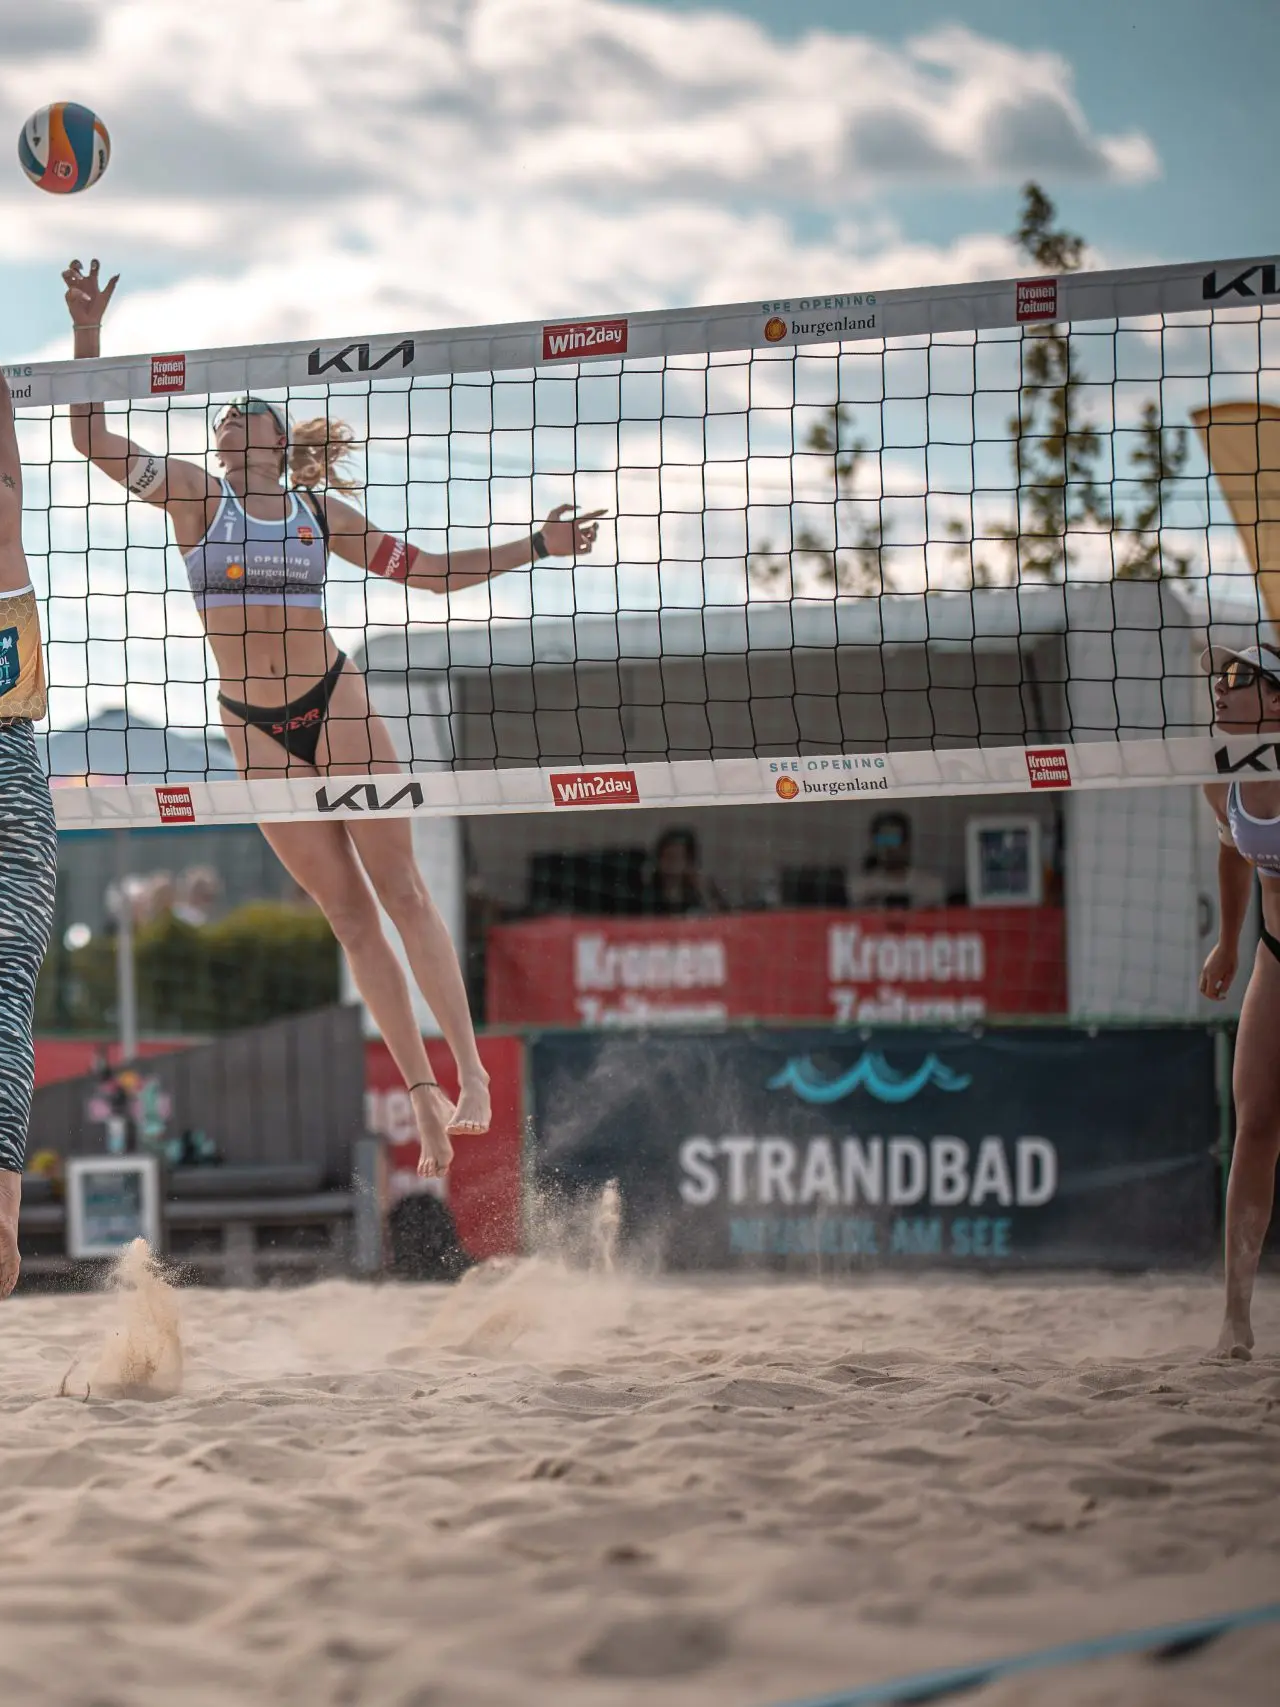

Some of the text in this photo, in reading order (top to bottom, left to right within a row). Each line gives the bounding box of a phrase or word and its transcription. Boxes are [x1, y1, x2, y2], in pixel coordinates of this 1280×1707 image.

[1018, 285, 1055, 299] Kronen
[762, 294, 878, 314] SEE OPENING
[1018, 299, 1055, 315] Zeitung
[791, 315, 877, 337] burgenland
[548, 325, 623, 355] win2day
[153, 360, 184, 374] Kronen
[308, 339, 415, 376] KIA
[152, 373, 184, 387] Zeitung
[223, 521, 234, 542] 1
[770, 757, 886, 772] SEE OPENING
[1027, 754, 1066, 769] Kronen
[1030, 768, 1069, 782] Zeitung
[556, 776, 632, 802] win2day
[802, 776, 889, 796] burgenland
[157, 790, 190, 805] Kronen
[315, 783, 424, 813] KIA
[160, 804, 193, 817] Zeitung
[574, 931, 728, 992] Kronen
[828, 923, 986, 983] Kronen
[677, 1134, 1059, 1208] STRANDBAD
[951, 1216, 1013, 1258] SEE
